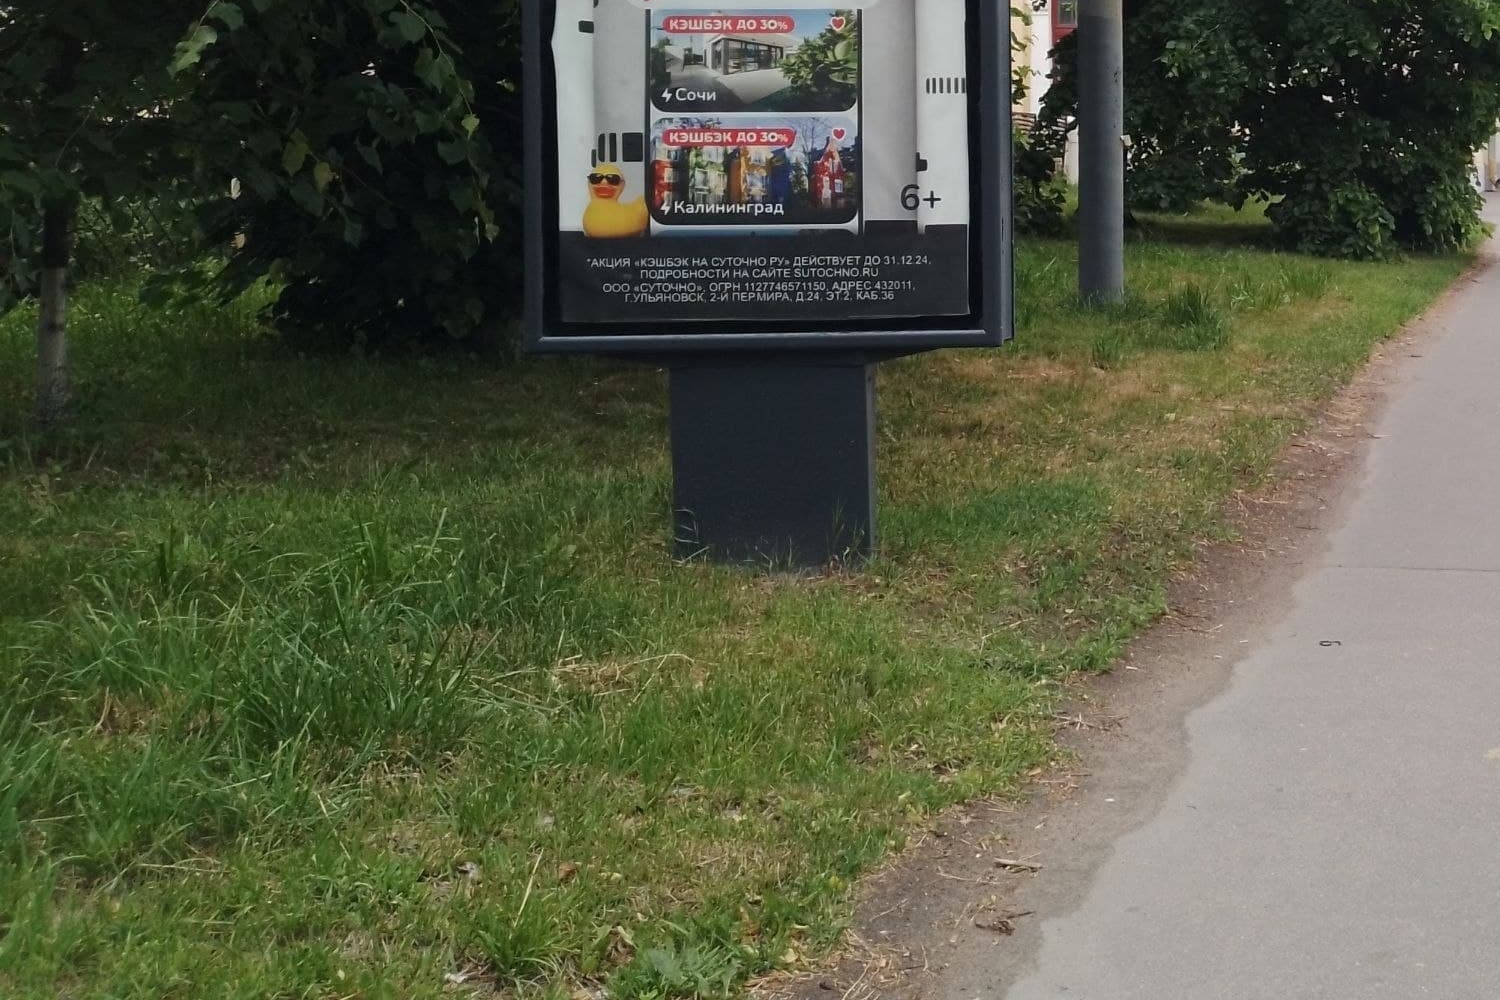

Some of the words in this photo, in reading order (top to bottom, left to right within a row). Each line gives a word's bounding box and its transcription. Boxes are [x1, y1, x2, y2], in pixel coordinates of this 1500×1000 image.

[669, 18, 732, 31] КЭШБЭК
[736, 19, 757, 31] ДО
[760, 19, 789, 31] 30%
[675, 88, 717, 102] Сочи
[669, 132, 732, 143] КЭШБЭК
[736, 132, 757, 143] ДО
[760, 131, 789, 143] 30%
[900, 183, 941, 211] 6+
[674, 200, 785, 216] Калининград
[634, 256, 689, 267] «КЭШБЭК
[692, 257, 708, 267] НА
[793, 254, 861, 267] ДЕЙСТВУЕТ
[863, 255, 881, 266] ДО
[640, 269, 730, 280] ПОДРОБНОСТИ
[733, 269, 750, 278] НА
[752, 266, 791, 278] САЙТЕ
[793, 267, 879, 278] SUTOCHNO.RU
[602, 283, 631, 293] ООО
[709, 282, 741, 293] ОГРН
[832, 281, 872, 293] АДРЕС
